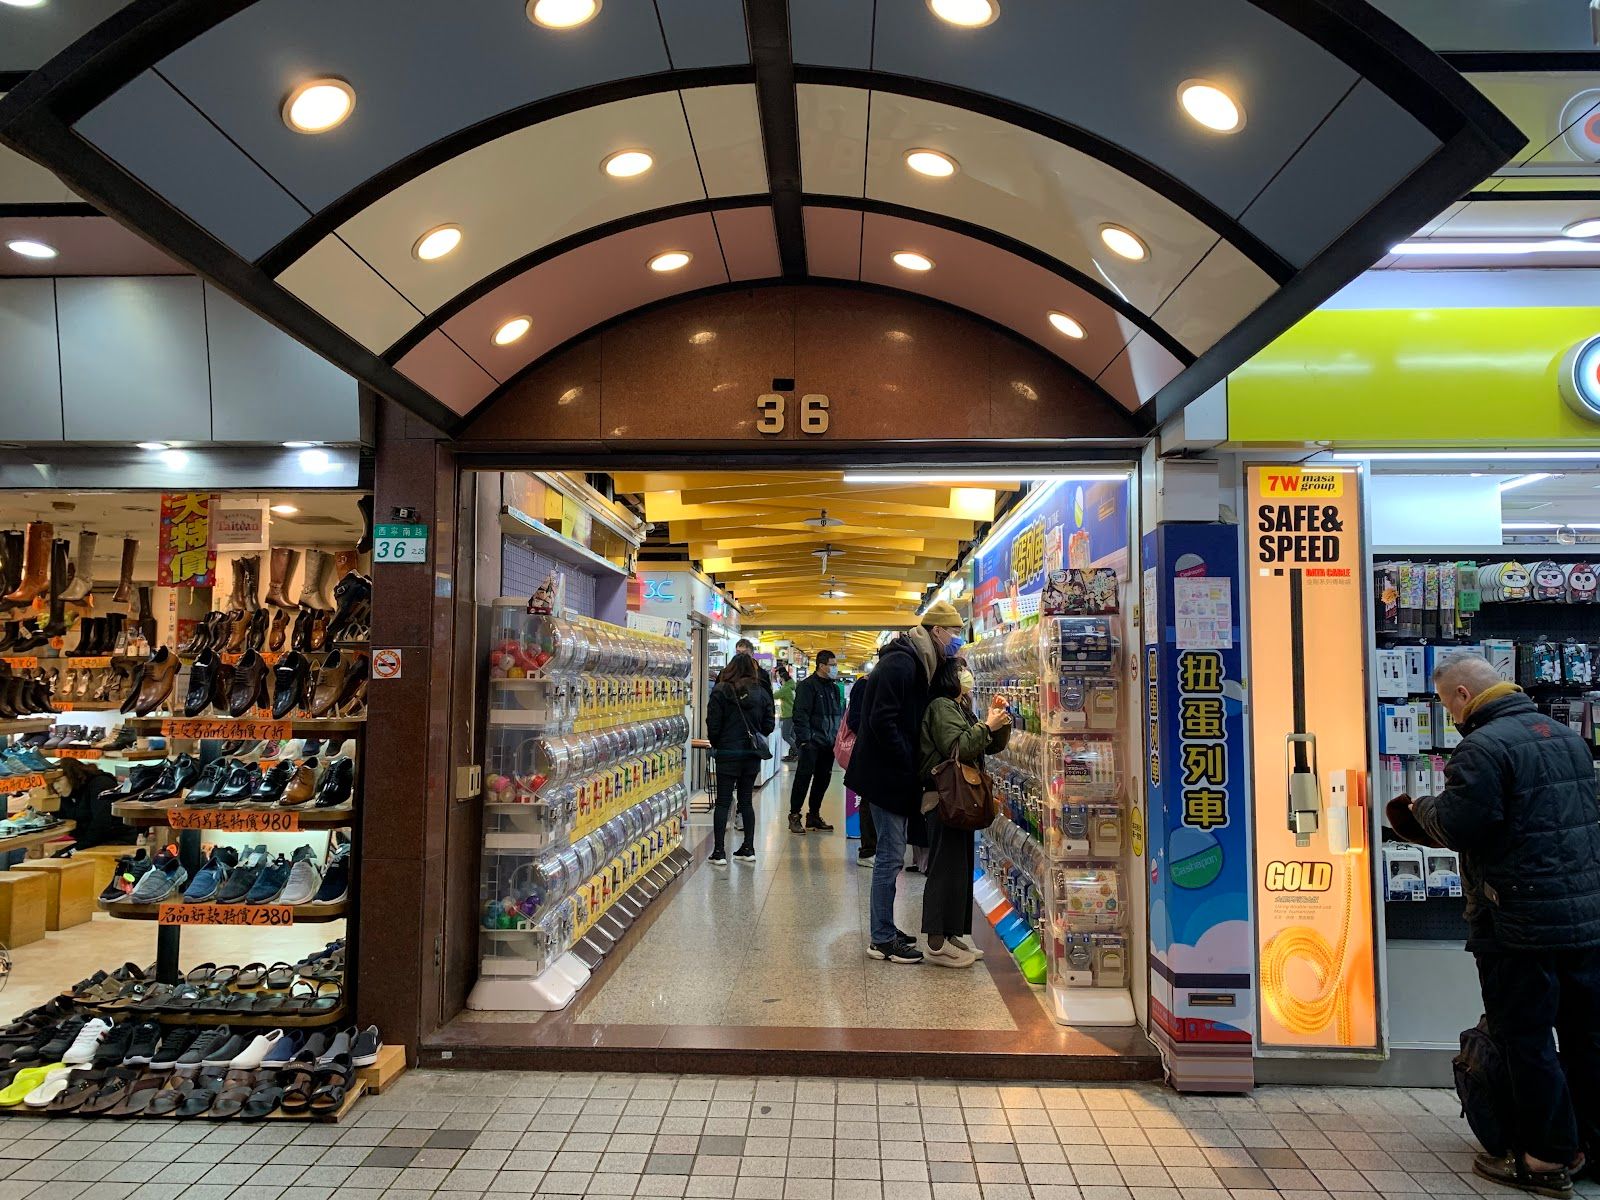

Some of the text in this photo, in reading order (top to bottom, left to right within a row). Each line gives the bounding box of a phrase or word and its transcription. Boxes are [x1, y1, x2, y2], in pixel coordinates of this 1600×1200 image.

[757, 394, 829, 433] 36
[1268, 475, 1300, 491] 7W
[1300, 482, 1335, 492] group
[1258, 505, 1344, 533] SAFE&
[377, 541, 406, 558] 36
[1259, 535, 1340, 563] SPEED
[643, 580, 674, 600] 3C
[1181, 651, 1228, 831] 扭蛋列車
[1265, 861, 1333, 892] GOLD
